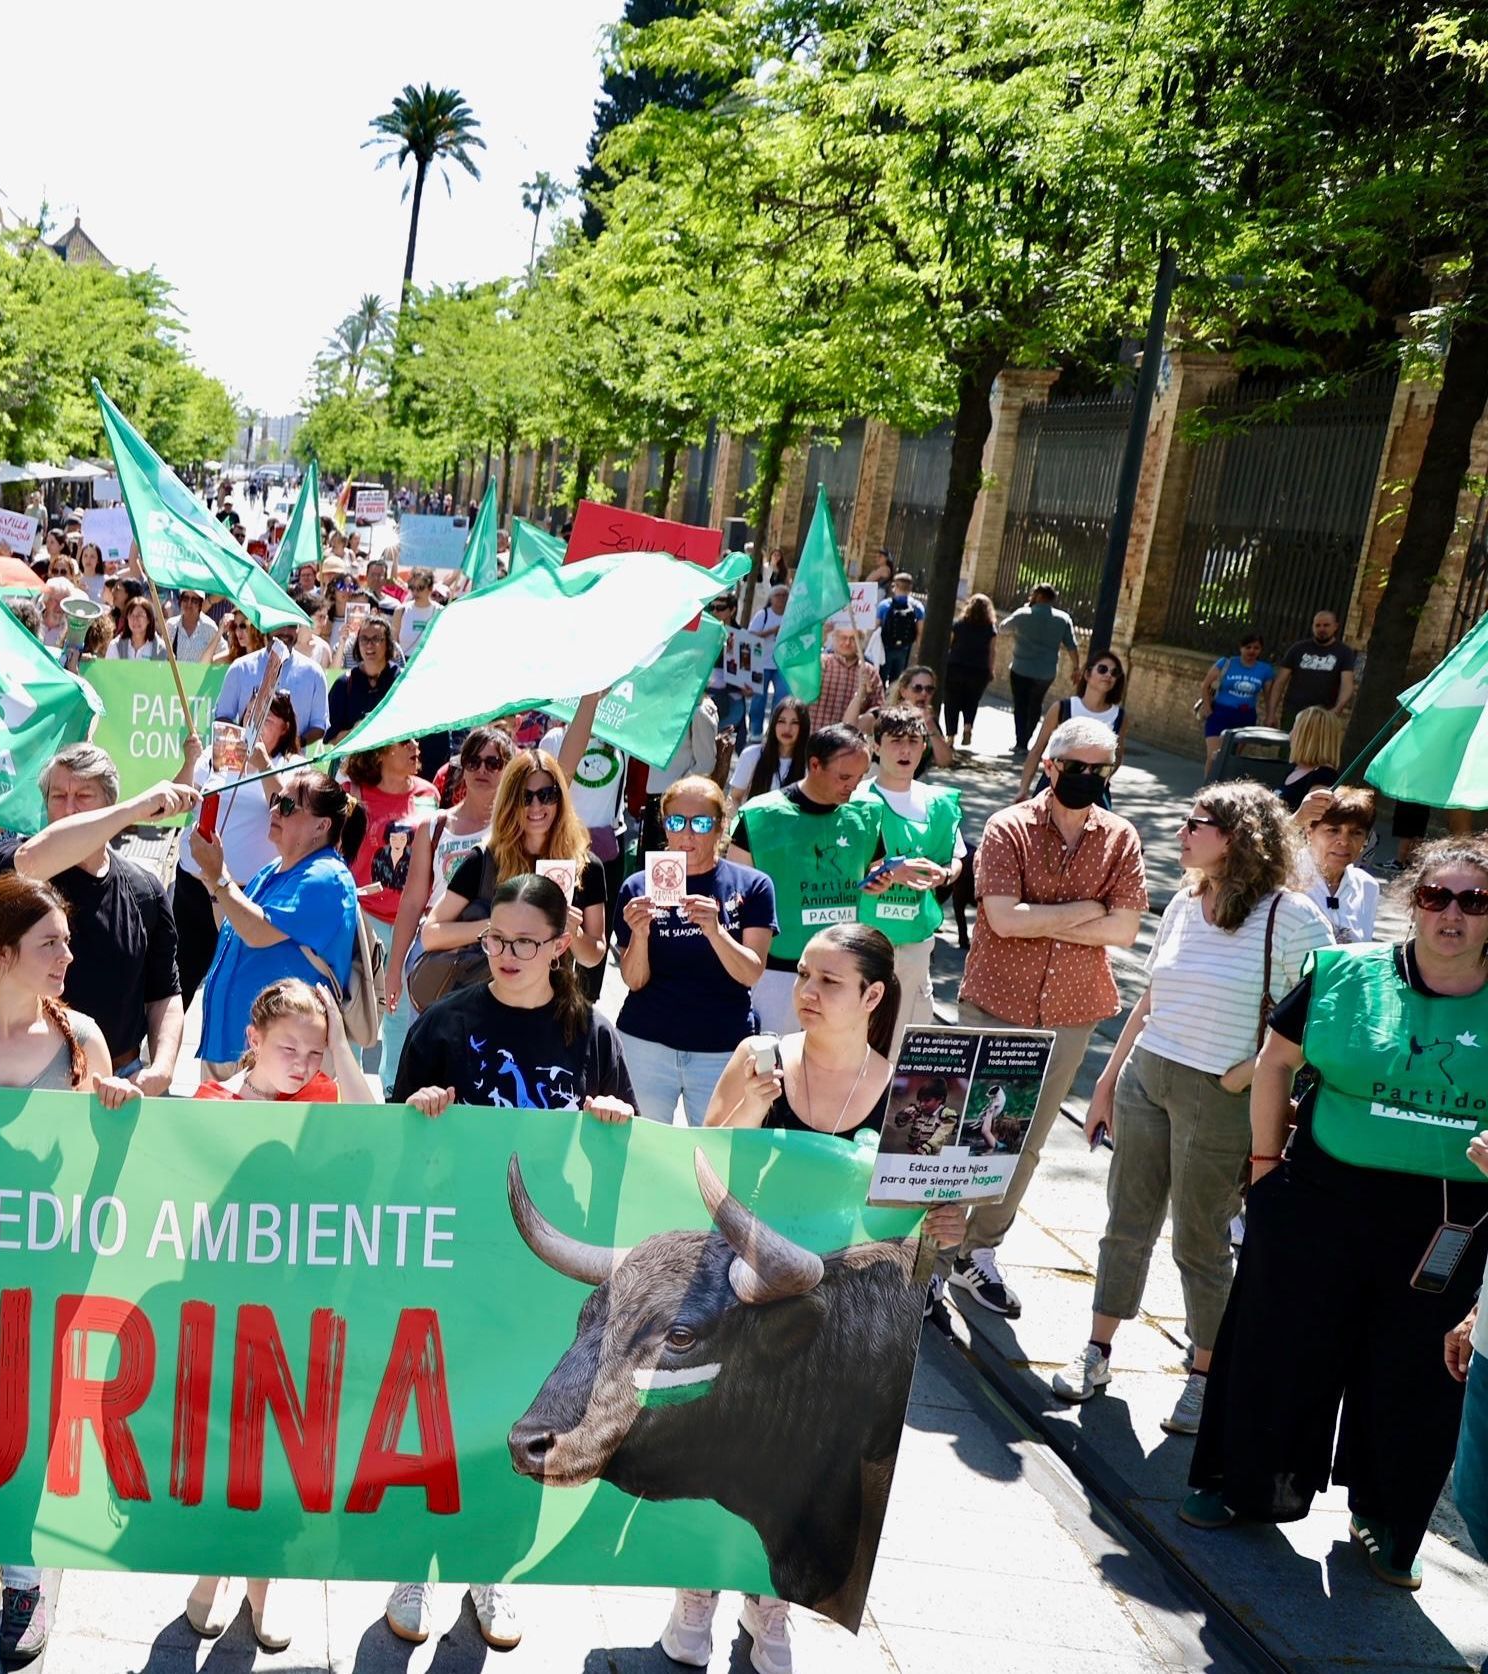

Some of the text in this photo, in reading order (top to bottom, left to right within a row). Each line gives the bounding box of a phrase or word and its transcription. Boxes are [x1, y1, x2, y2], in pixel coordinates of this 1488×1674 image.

[598, 699, 627, 720] LISTA
[129, 730, 180, 759] CON
[800, 878, 858, 892] Partido
[809, 909, 853, 922] PACMA
[659, 929, 670, 938] THE
[1373, 1082, 1487, 1110] Partido
[909, 1162, 939, 1172] Educa
[952, 1164, 966, 1173] tus
[968, 1163, 989, 1174] hijos
[880, 1174, 1003, 1187] para que siempre hagan
[924, 1188, 935, 1198] el
[145, 1198, 458, 1270] AMBIENTE
